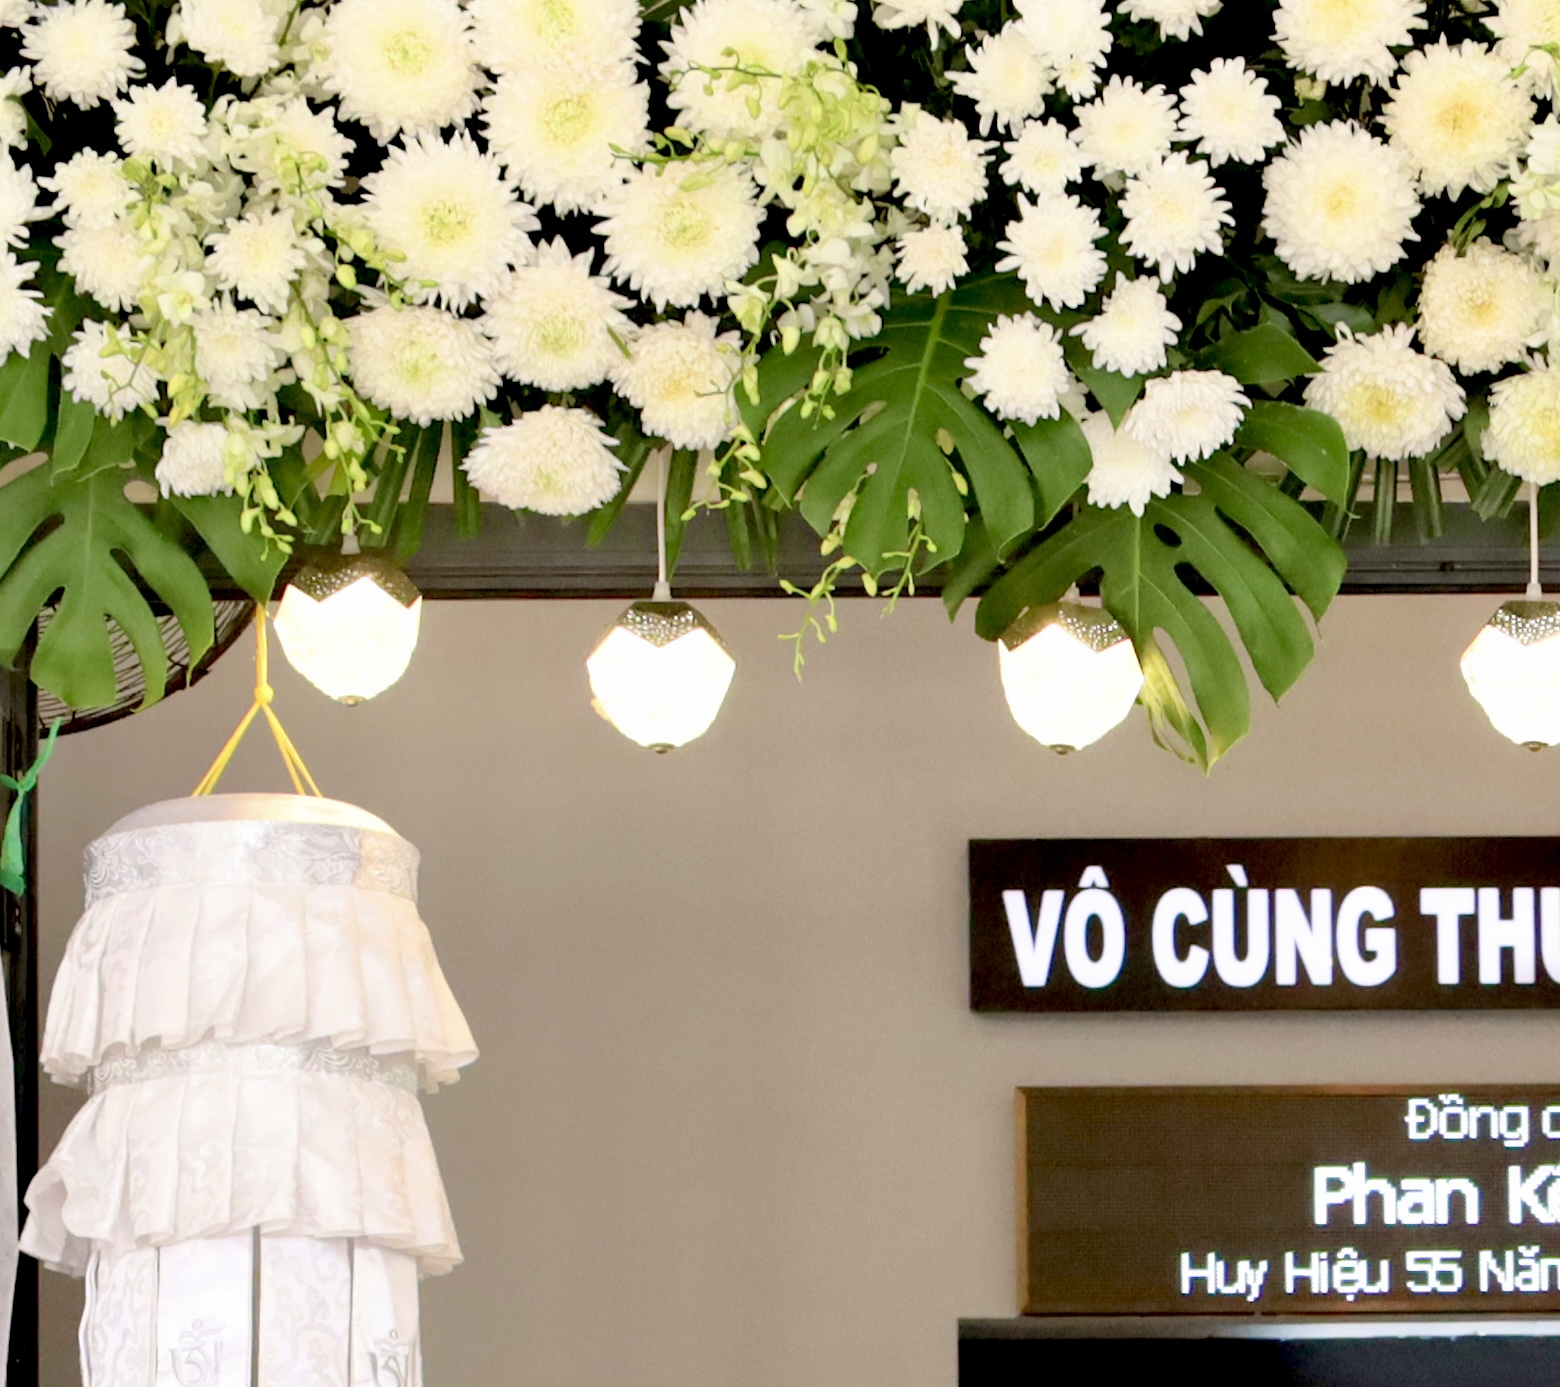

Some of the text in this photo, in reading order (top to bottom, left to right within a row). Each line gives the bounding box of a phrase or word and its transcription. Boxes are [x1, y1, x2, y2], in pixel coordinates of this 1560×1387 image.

[1002, 866, 1125, 988] VÔ
[1151, 864, 1397, 988] CÙNG
[1403, 1093, 1530, 1148] Đồng
[1313, 1161, 1480, 1225] Phan
[1180, 1251, 1269, 1302] Huy
[1284, 1246, 1390, 1302] Hiệu
[1404, 1249, 1463, 1293] 55
